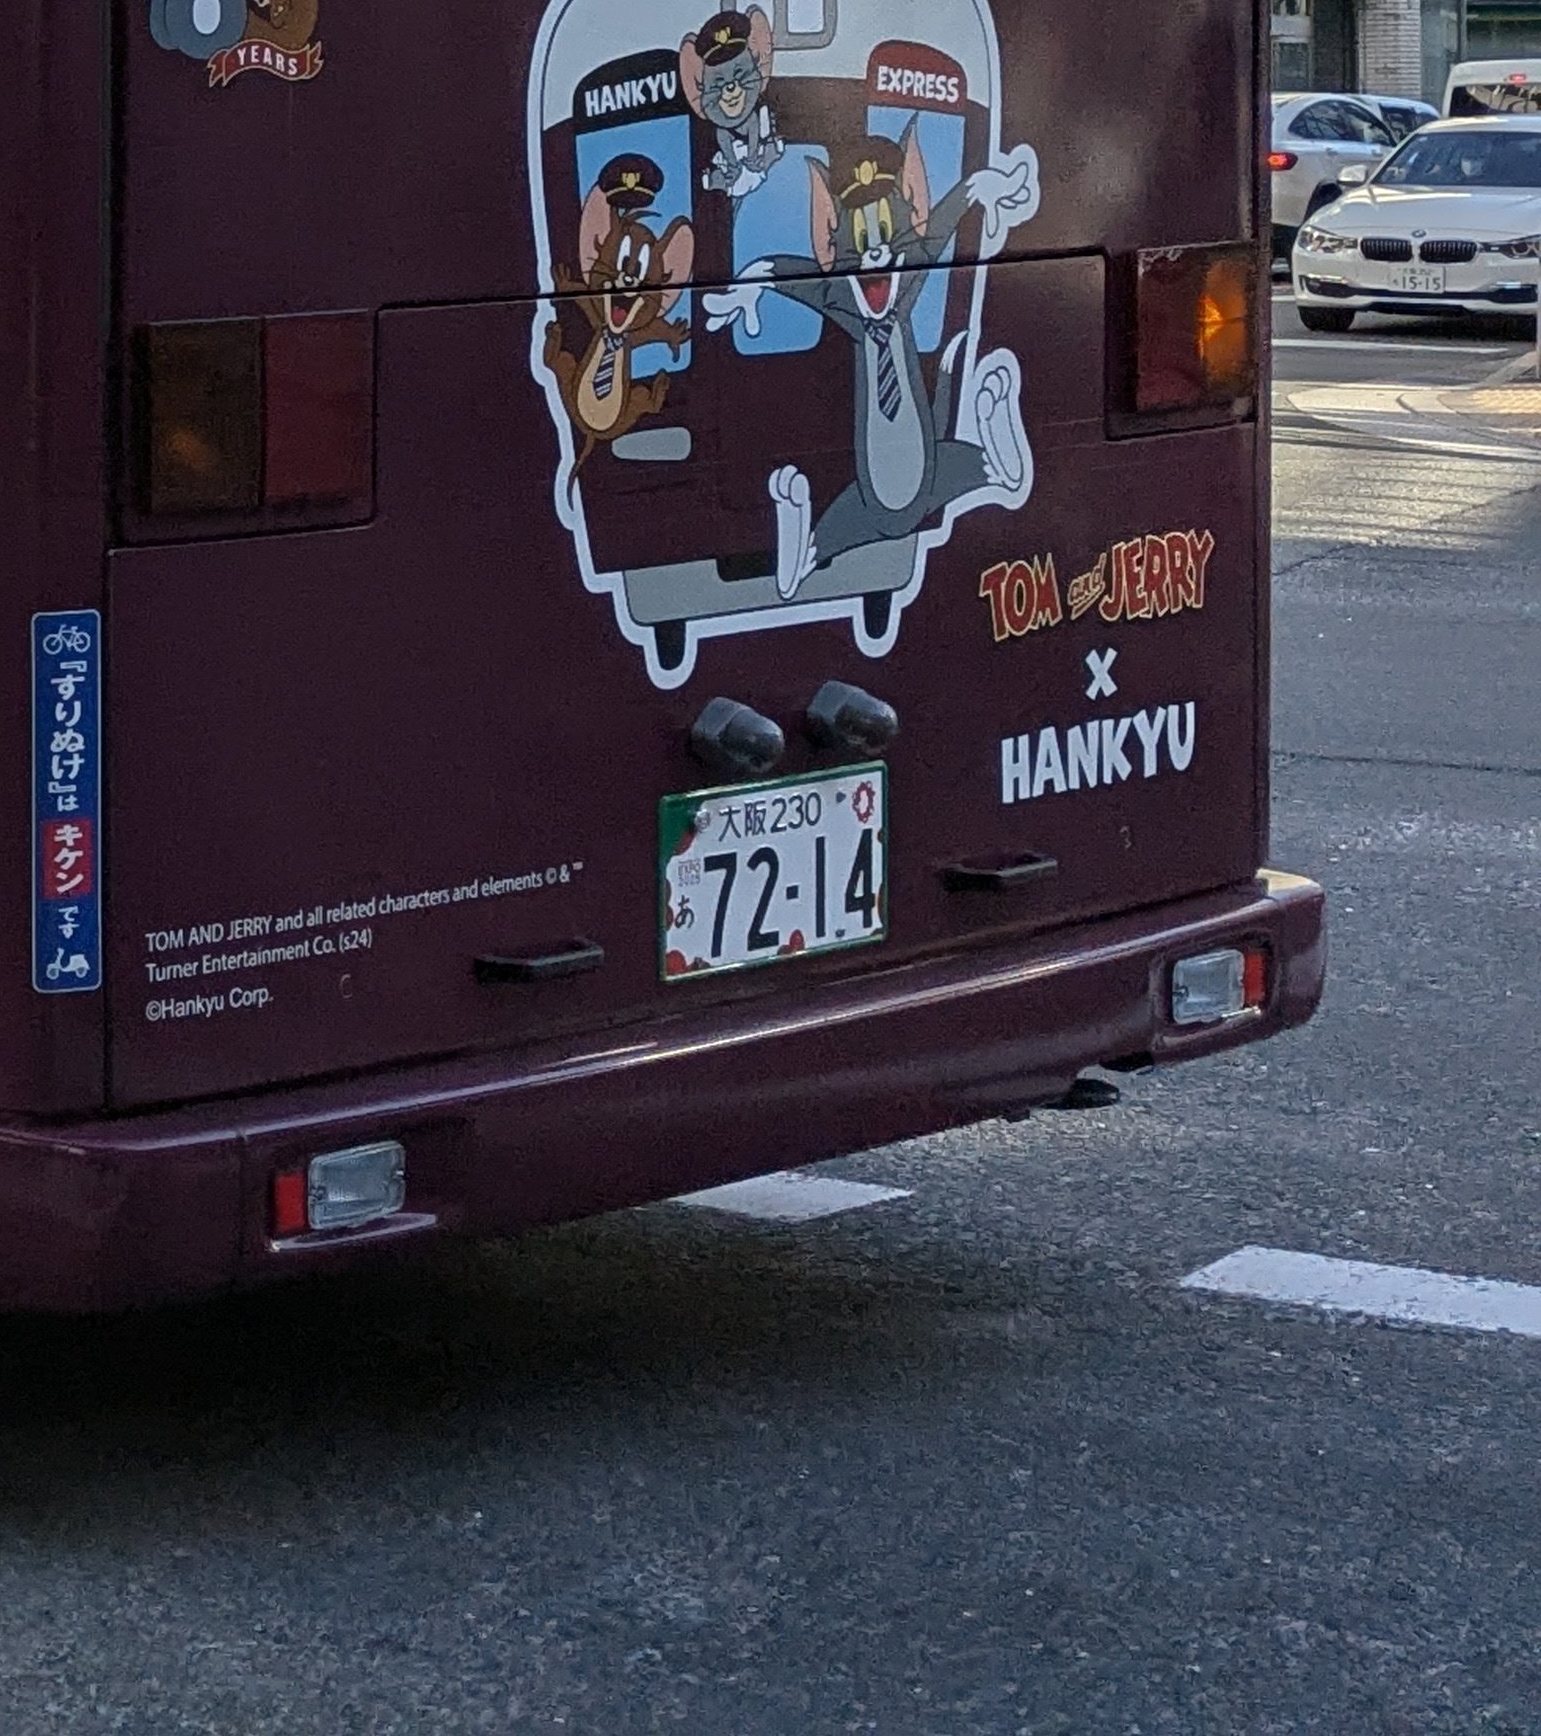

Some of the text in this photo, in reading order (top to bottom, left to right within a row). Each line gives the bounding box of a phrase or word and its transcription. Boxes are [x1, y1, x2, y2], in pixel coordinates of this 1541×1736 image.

[237, 45, 298, 76] YEARS
[585, 65, 960, 116] HANKYU EXPRESS
[979, 552, 1063, 643] TOM
[1099, 529, 1215, 622] JERRY
[1001, 701, 1195, 804] HANKYU
[145, 932, 184, 953] TOM
[189, 924, 224, 947] AND
[227, 915, 272, 942] JERRY
[275, 910, 304, 933] and
[307, 905, 323, 927] all
[326, 896, 376, 924] related
[378, 888, 449, 916] characters
[453, 879, 478, 903] and
[481, 870, 543, 897] elements
[559, 864, 570, 883] &
[674, 828, 876, 959] あ 72-14
[146, 927, 373, 984] Turner Entertainment Co. (s24)
[146, 985, 274, 1022] ©Hankyu Corp.
